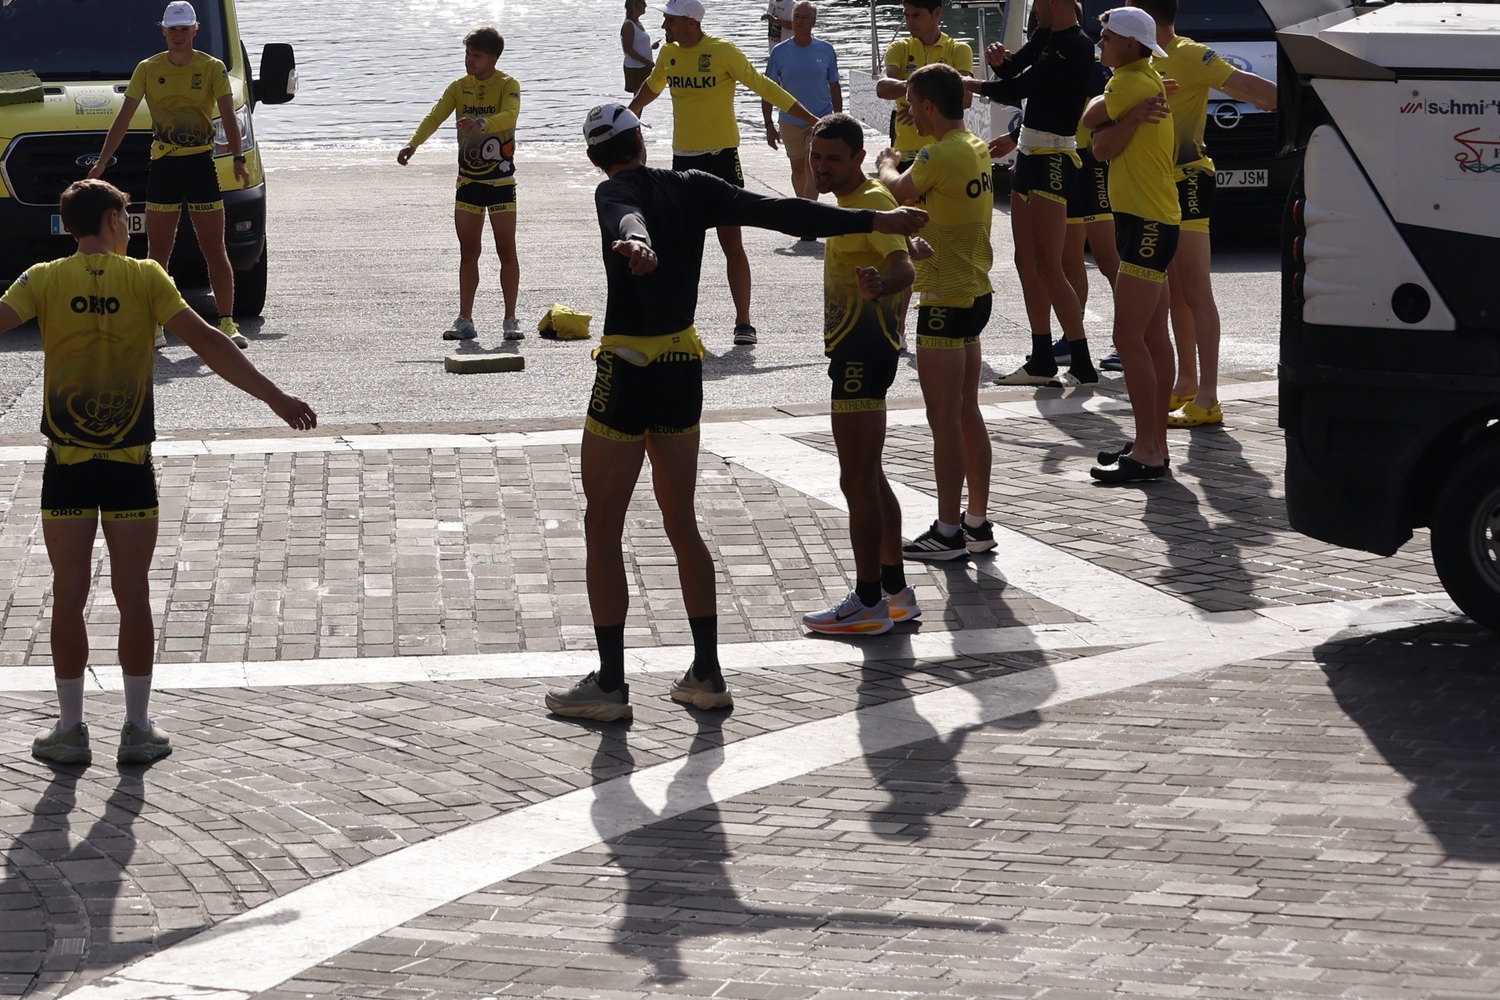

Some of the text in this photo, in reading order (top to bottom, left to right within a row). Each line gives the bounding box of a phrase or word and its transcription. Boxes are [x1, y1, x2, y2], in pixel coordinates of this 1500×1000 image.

[666, 76, 716, 88] ORIALKI
[1239, 171, 1265, 185] JSM
[1094, 168, 1109, 208] ORIALKI
[843, 361, 864, 393] ORI
[51, 509, 83, 517] ORIO
